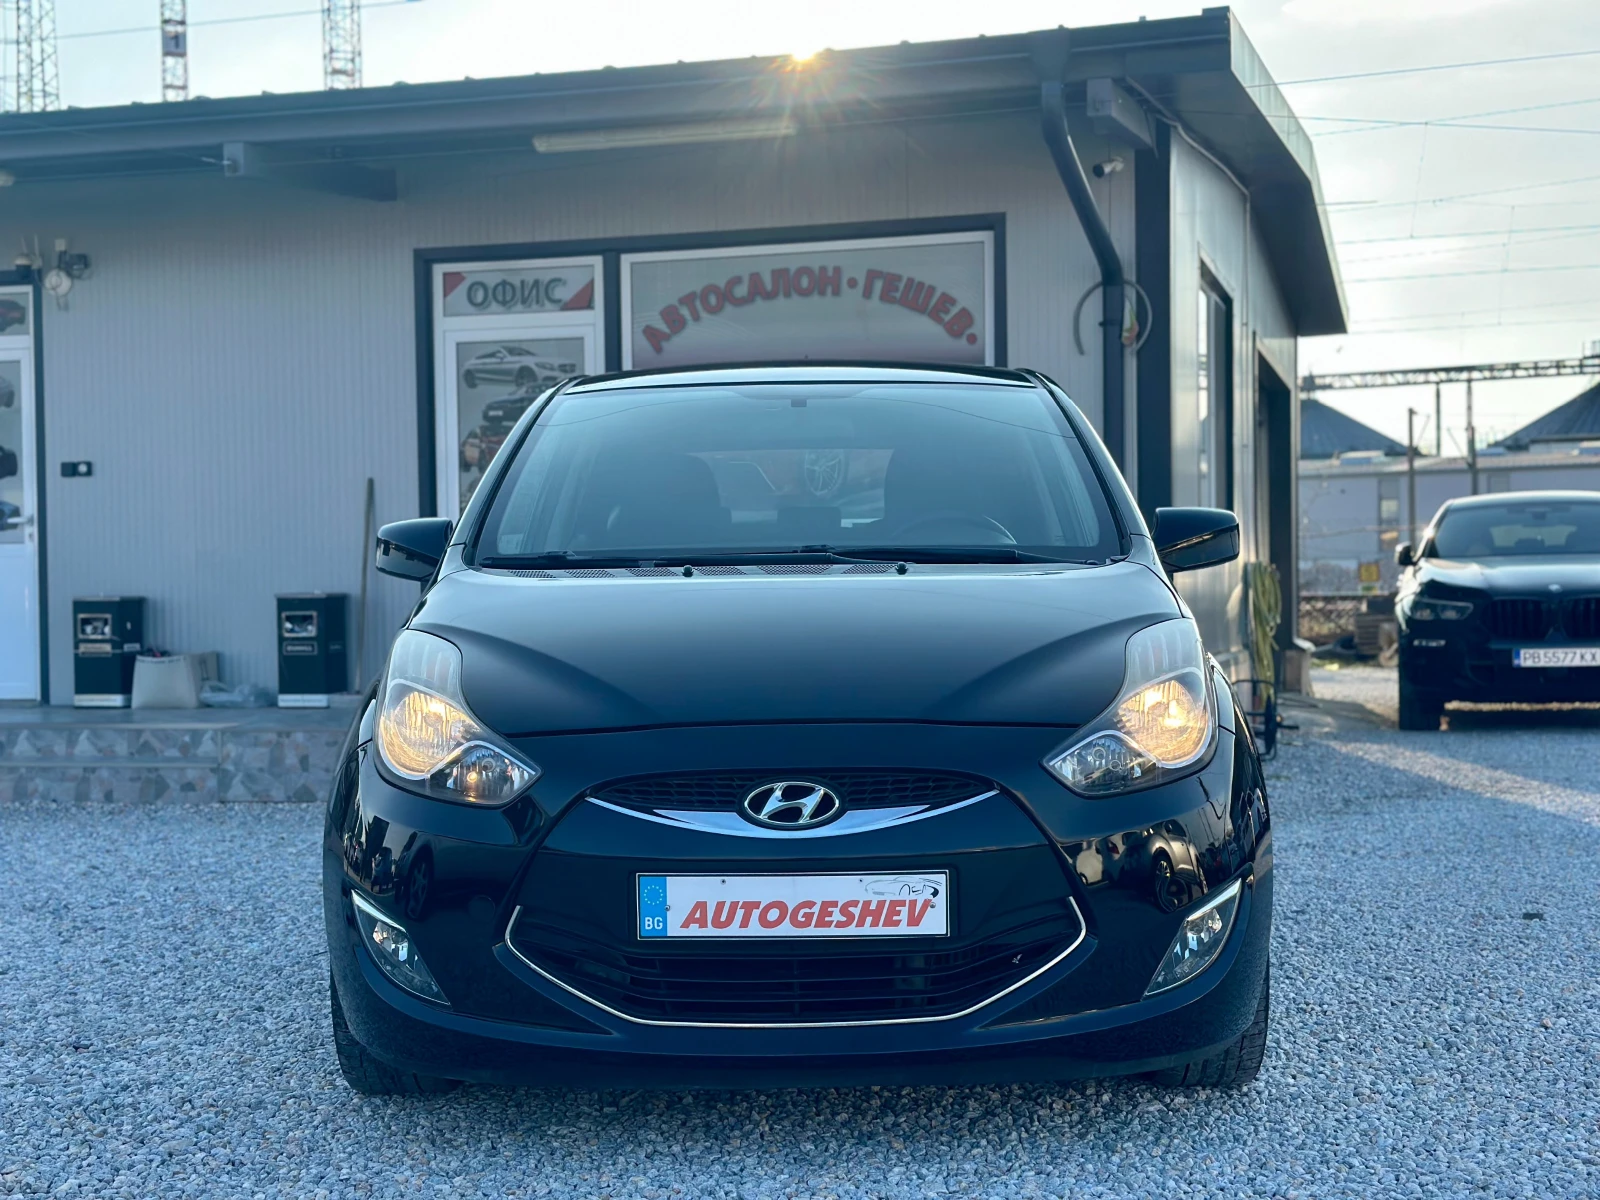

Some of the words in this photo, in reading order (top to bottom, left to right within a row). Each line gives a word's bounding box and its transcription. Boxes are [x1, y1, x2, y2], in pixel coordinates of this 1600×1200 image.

[466, 277, 567, 310] ОФИС
[644, 916, 663, 930] BG
[679, 898, 933, 930] AUTOGESHEV
